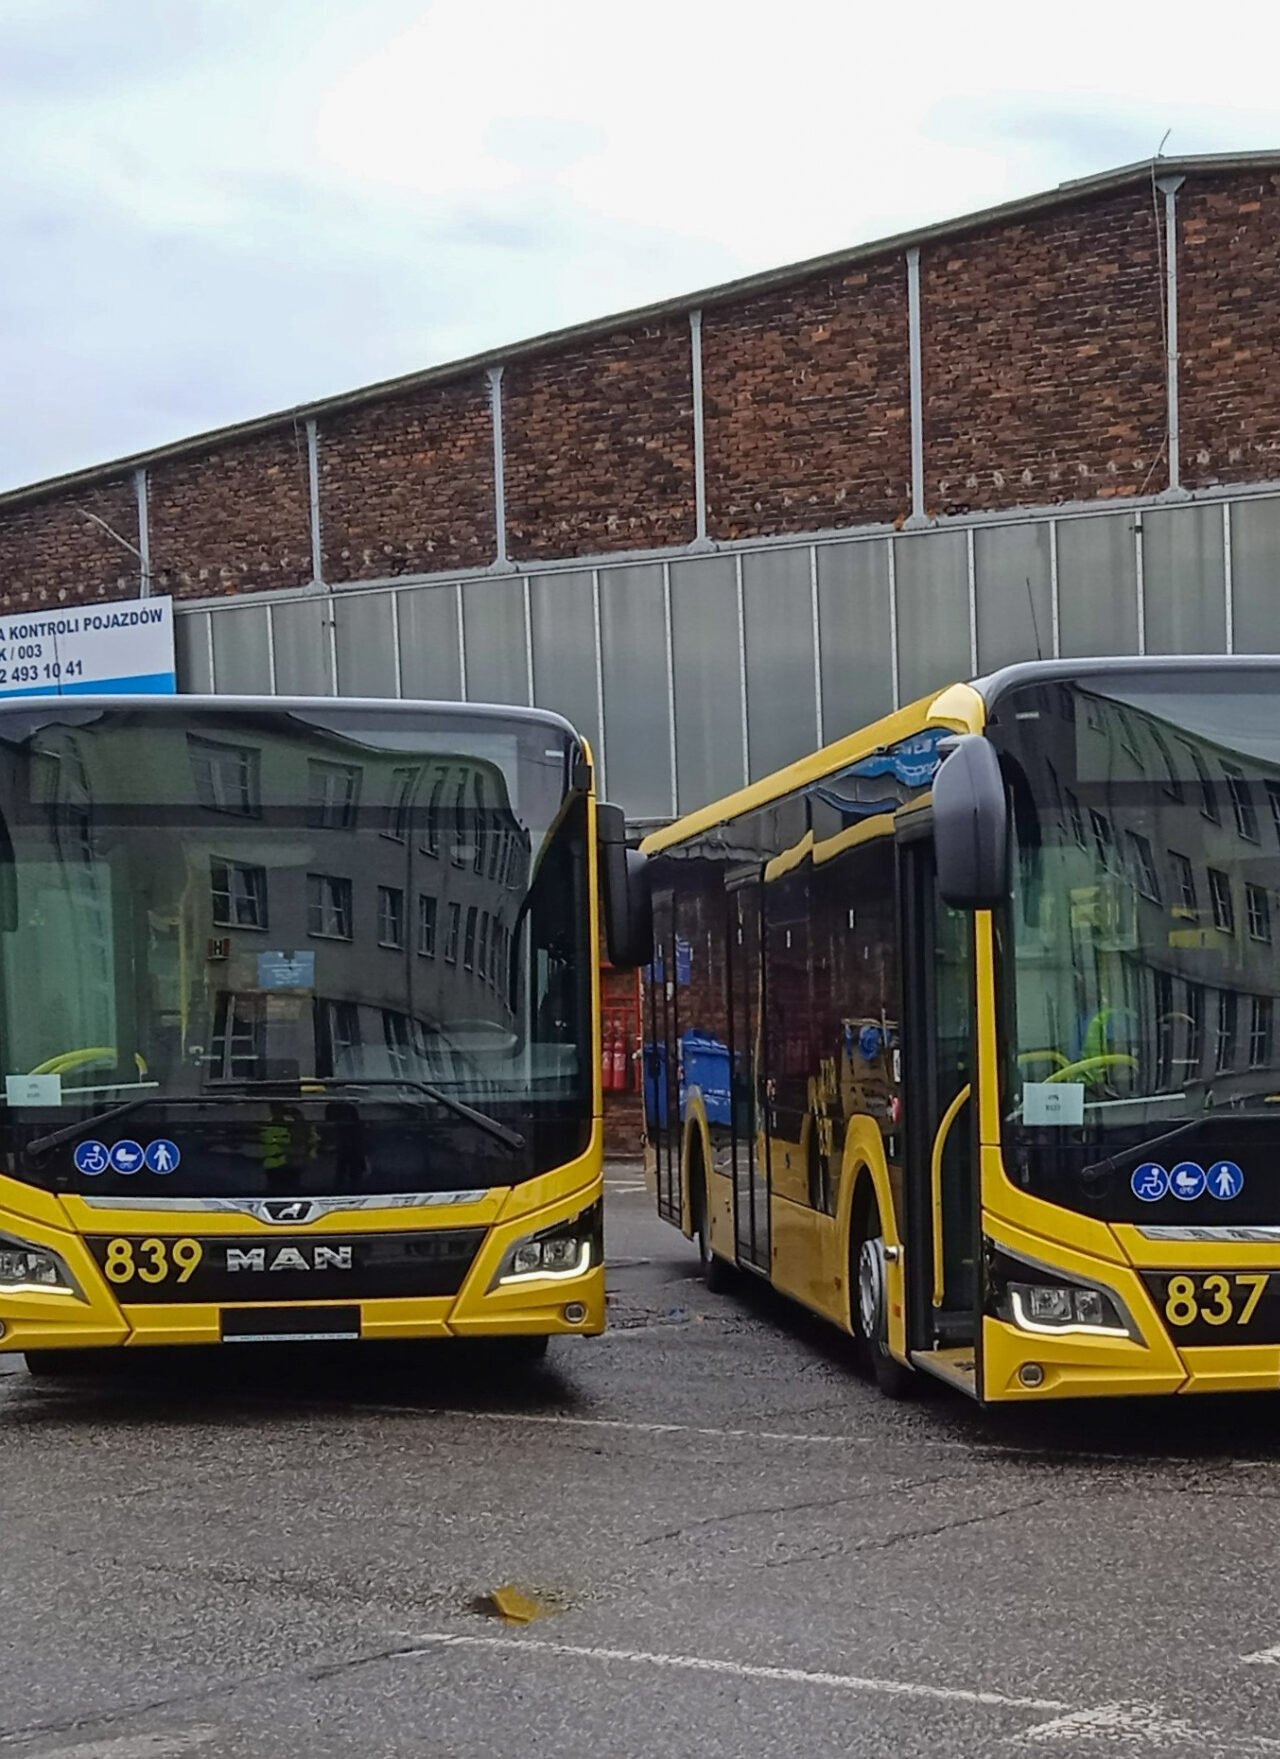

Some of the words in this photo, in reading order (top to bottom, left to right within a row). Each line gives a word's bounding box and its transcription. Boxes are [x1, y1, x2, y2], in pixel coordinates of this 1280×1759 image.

[9, 619, 79, 640] KONTROLI
[84, 607, 163, 631] POJAZDÓW
[18, 644, 42, 660] 003
[11, 665, 39, 682] 493
[43, 662, 61, 679] 10
[66, 659, 83, 676] 41
[104, 1238, 203, 1284] 839
[226, 1246, 353, 1272] MAN
[1165, 1274, 1270, 1326] 837
